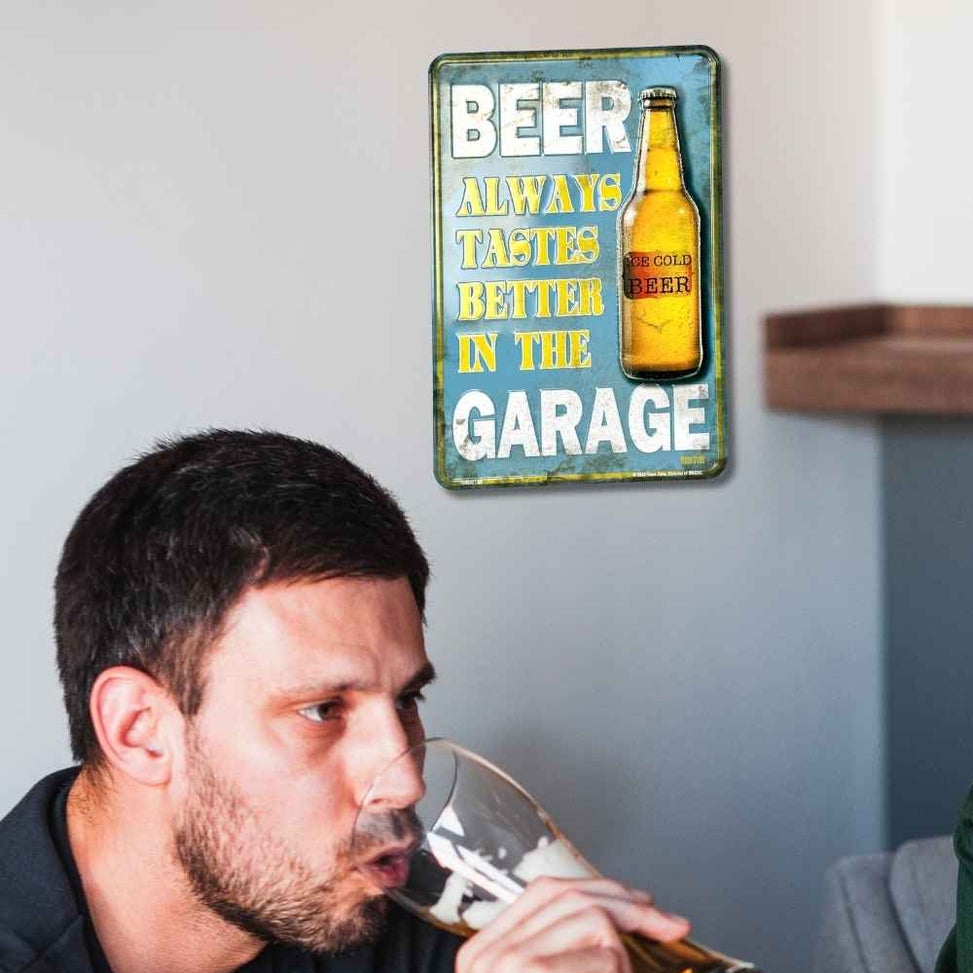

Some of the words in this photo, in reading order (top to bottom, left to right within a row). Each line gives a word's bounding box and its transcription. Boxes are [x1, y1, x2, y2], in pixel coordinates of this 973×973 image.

[451, 80, 632, 158] BEER
[455, 173, 623, 217] ALWAYS
[455, 226, 600, 270] TASTES
[627, 255, 650, 267] CE
[653, 254, 692, 266] COLD
[457, 277, 605, 322] BETTER
[629, 276, 691, 295] BEER
[457, 331, 498, 373] IN
[514, 329, 592, 371] THE
[452, 383, 710, 462] GARAGE
